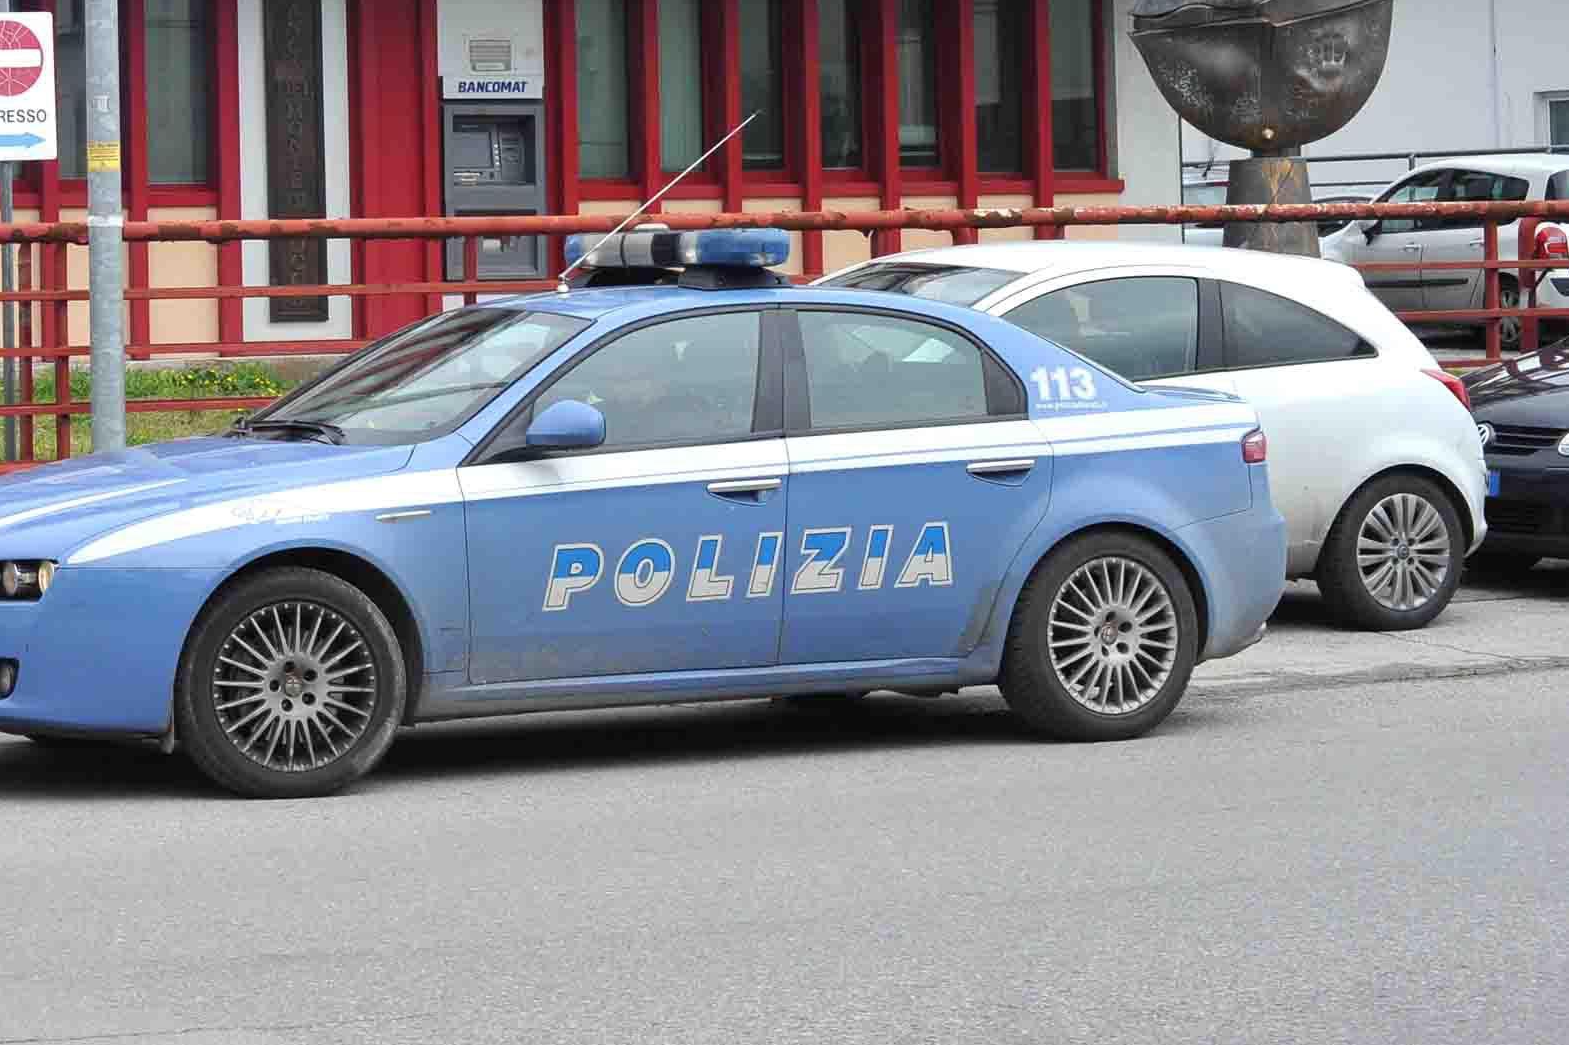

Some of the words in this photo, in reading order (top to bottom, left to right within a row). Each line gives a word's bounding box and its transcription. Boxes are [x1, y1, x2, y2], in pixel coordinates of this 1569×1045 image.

[458, 80, 528, 93] BANCOMAT
[1030, 365, 1096, 400] 113
[541, 520, 954, 612] POLIZIA
